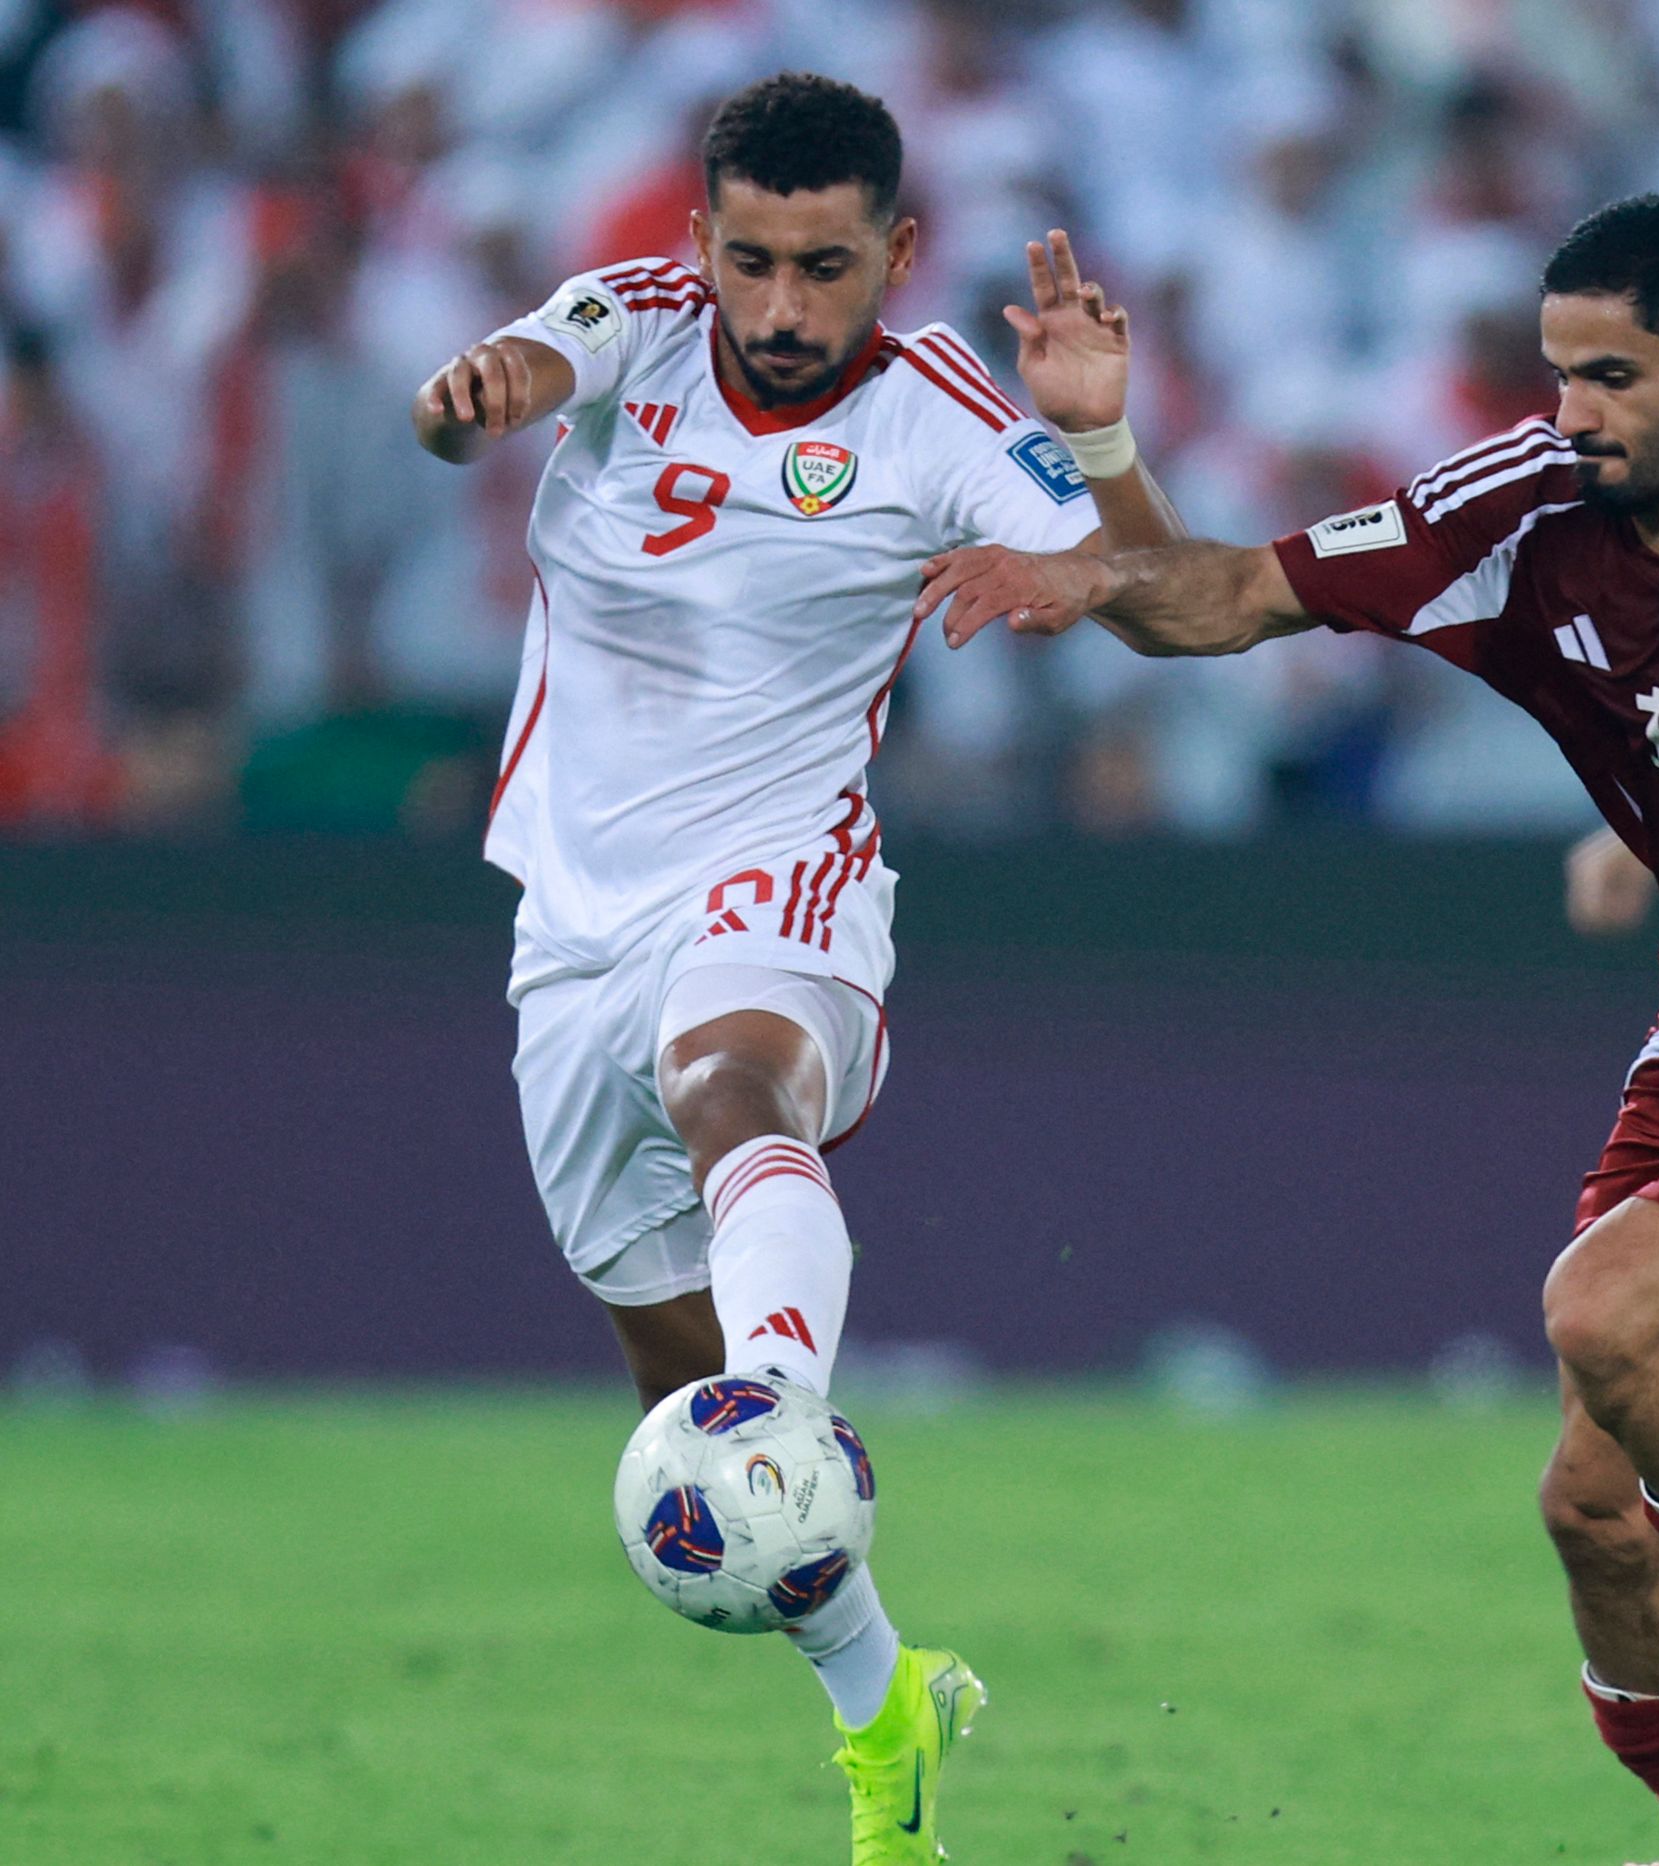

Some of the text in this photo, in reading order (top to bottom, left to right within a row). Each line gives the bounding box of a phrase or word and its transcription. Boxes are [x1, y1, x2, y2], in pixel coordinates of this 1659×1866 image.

[802, 461, 836, 475] UAE
[807, 474, 826, 484] FA
[641, 463, 731, 555] 9
